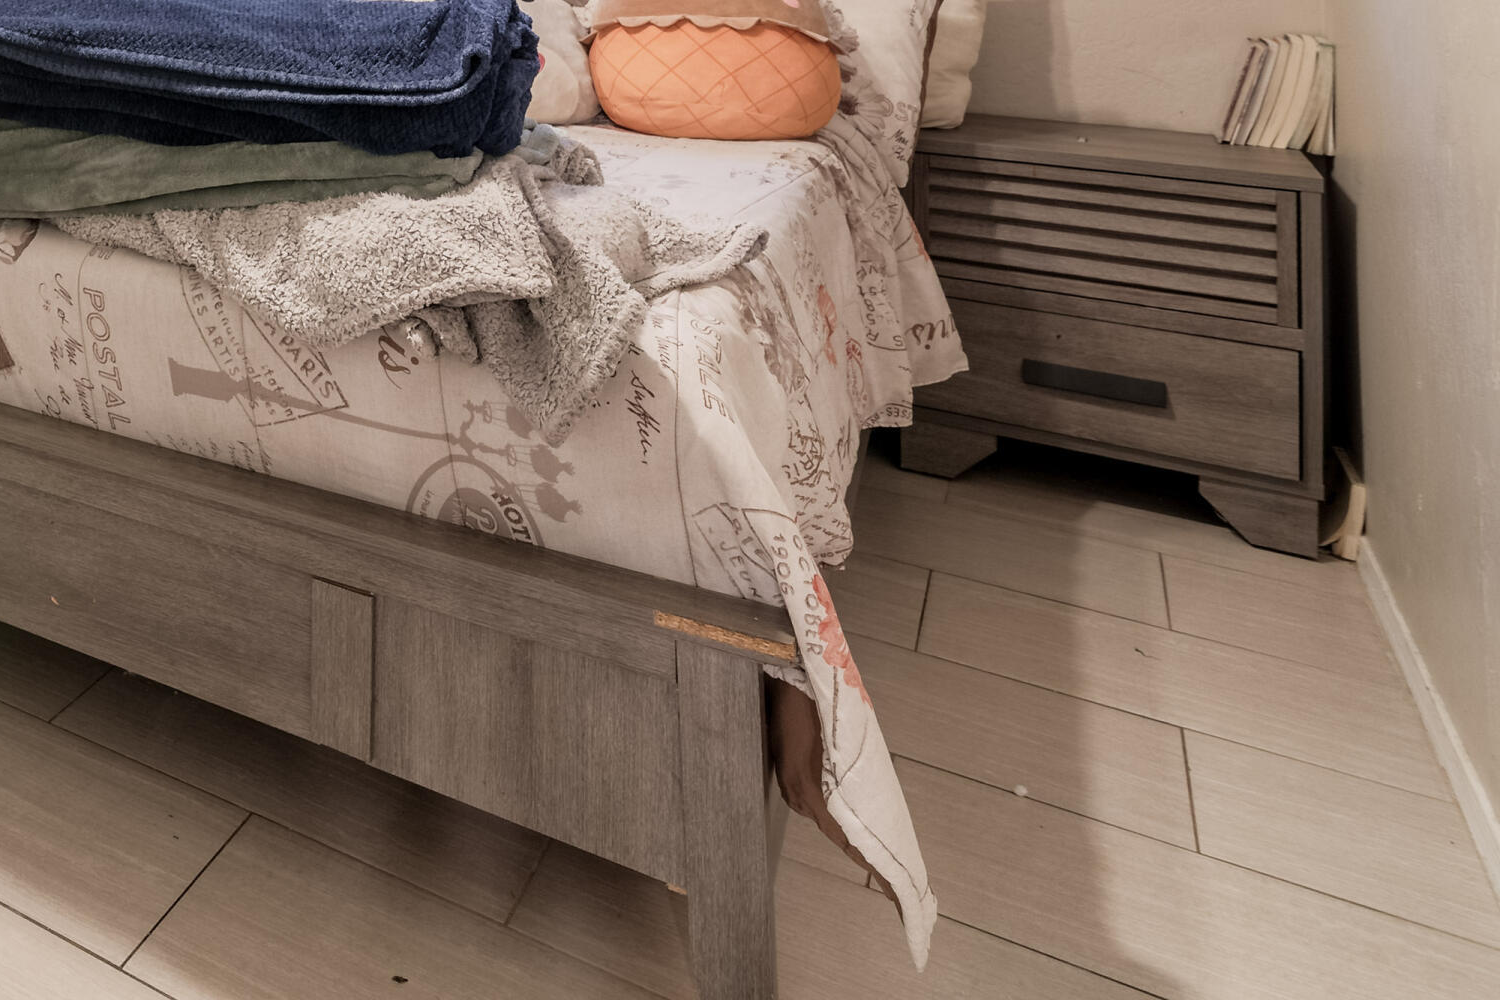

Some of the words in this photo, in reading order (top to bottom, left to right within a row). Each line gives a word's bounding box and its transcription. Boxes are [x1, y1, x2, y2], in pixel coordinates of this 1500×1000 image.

[83, 286, 132, 430] POSTAL
[279, 335, 335, 400] PARIS
[772, 532, 795, 598] 1906
